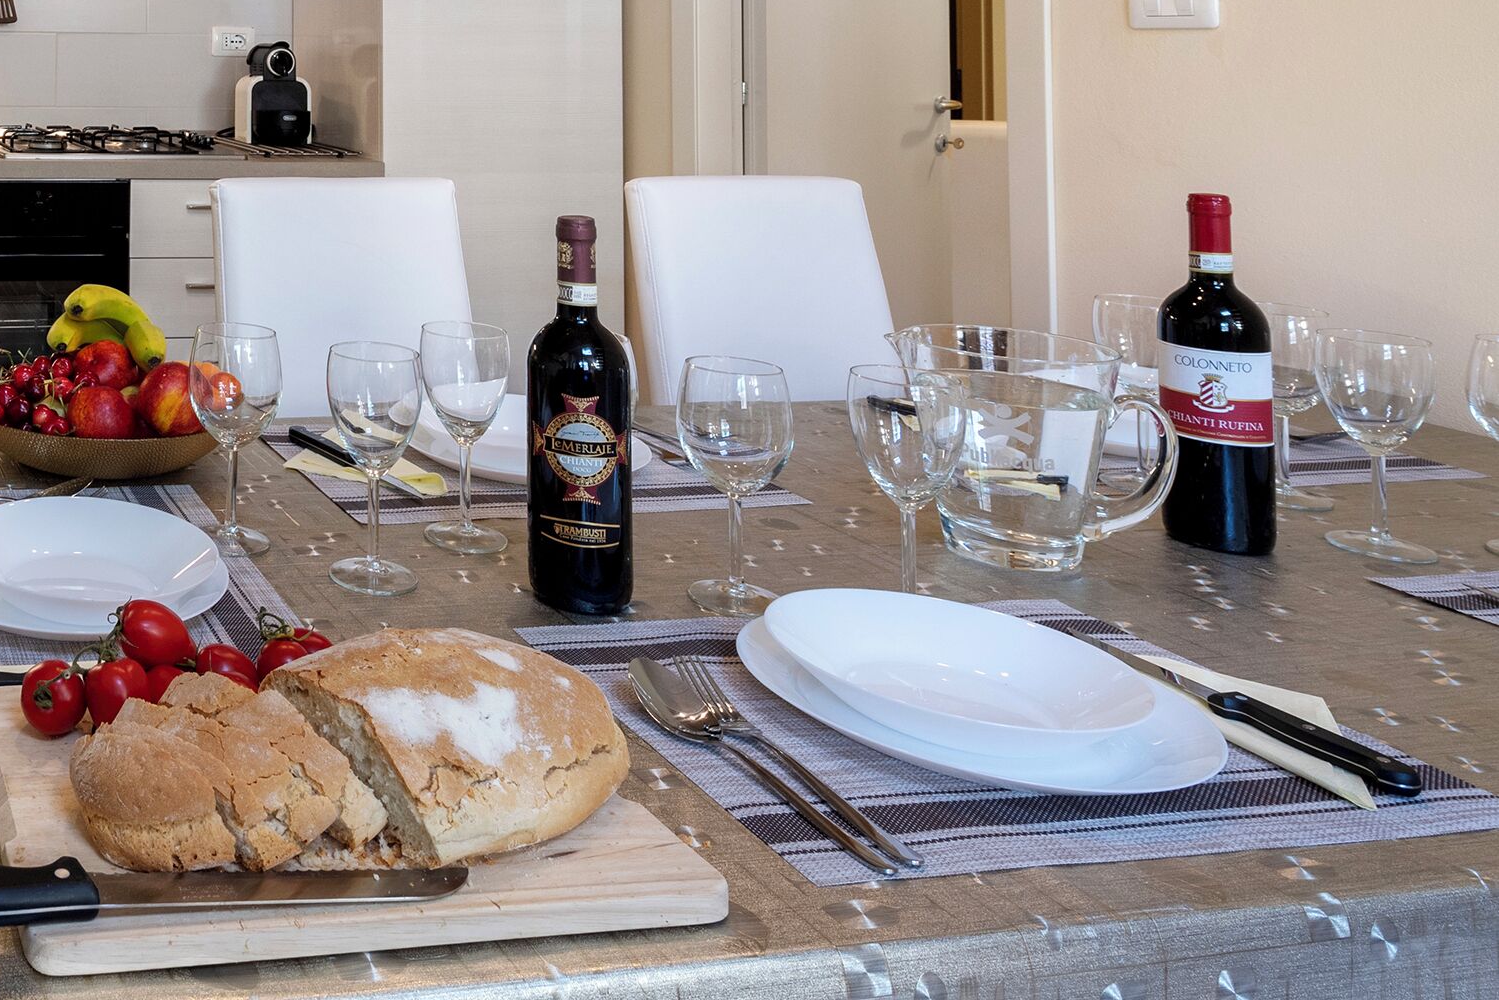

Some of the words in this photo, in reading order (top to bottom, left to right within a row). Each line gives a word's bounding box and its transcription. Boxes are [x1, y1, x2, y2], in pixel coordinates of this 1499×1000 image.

[1174, 353, 1253, 374] COLONNETO
[1167, 409, 1216, 428] CHIANTI
[1218, 419, 1265, 432] RUFINA
[559, 455, 603, 467] CHIANTI
[559, 525, 606, 538] TRAMBUSTI
